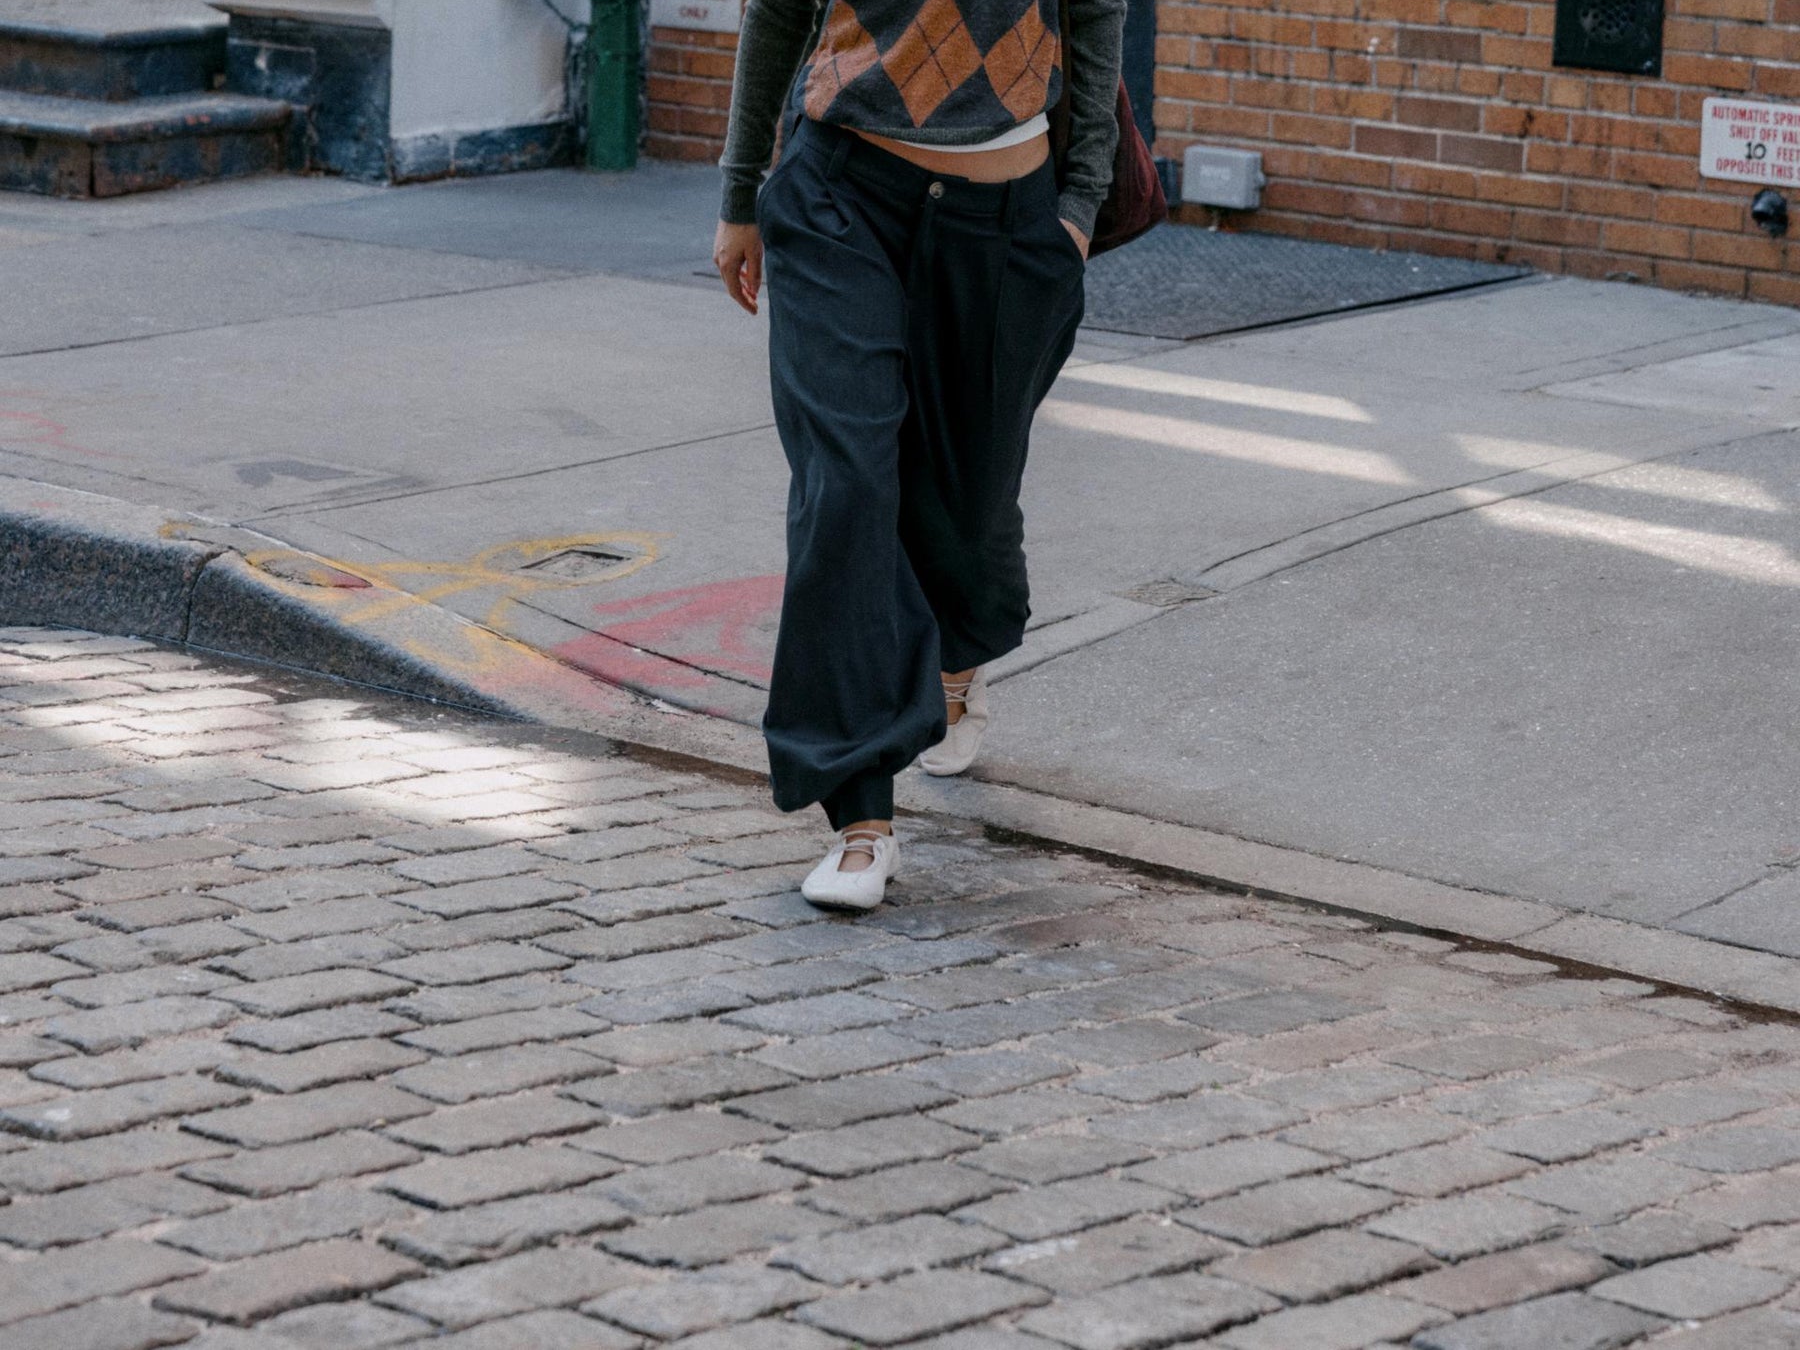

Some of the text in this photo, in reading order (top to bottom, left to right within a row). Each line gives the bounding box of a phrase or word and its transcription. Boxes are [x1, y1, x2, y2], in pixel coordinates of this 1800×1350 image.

[679, 5, 708, 19] ONLY
[1712, 105, 1769, 123] AUTOMATIC
[1730, 124, 1755, 140] SHUT
[1759, 127, 1777, 142] OFF
[1745, 141, 1767, 160] 10
[1716, 157, 1767, 177] OPPOSITE
[1771, 163, 1793, 180] THIS
